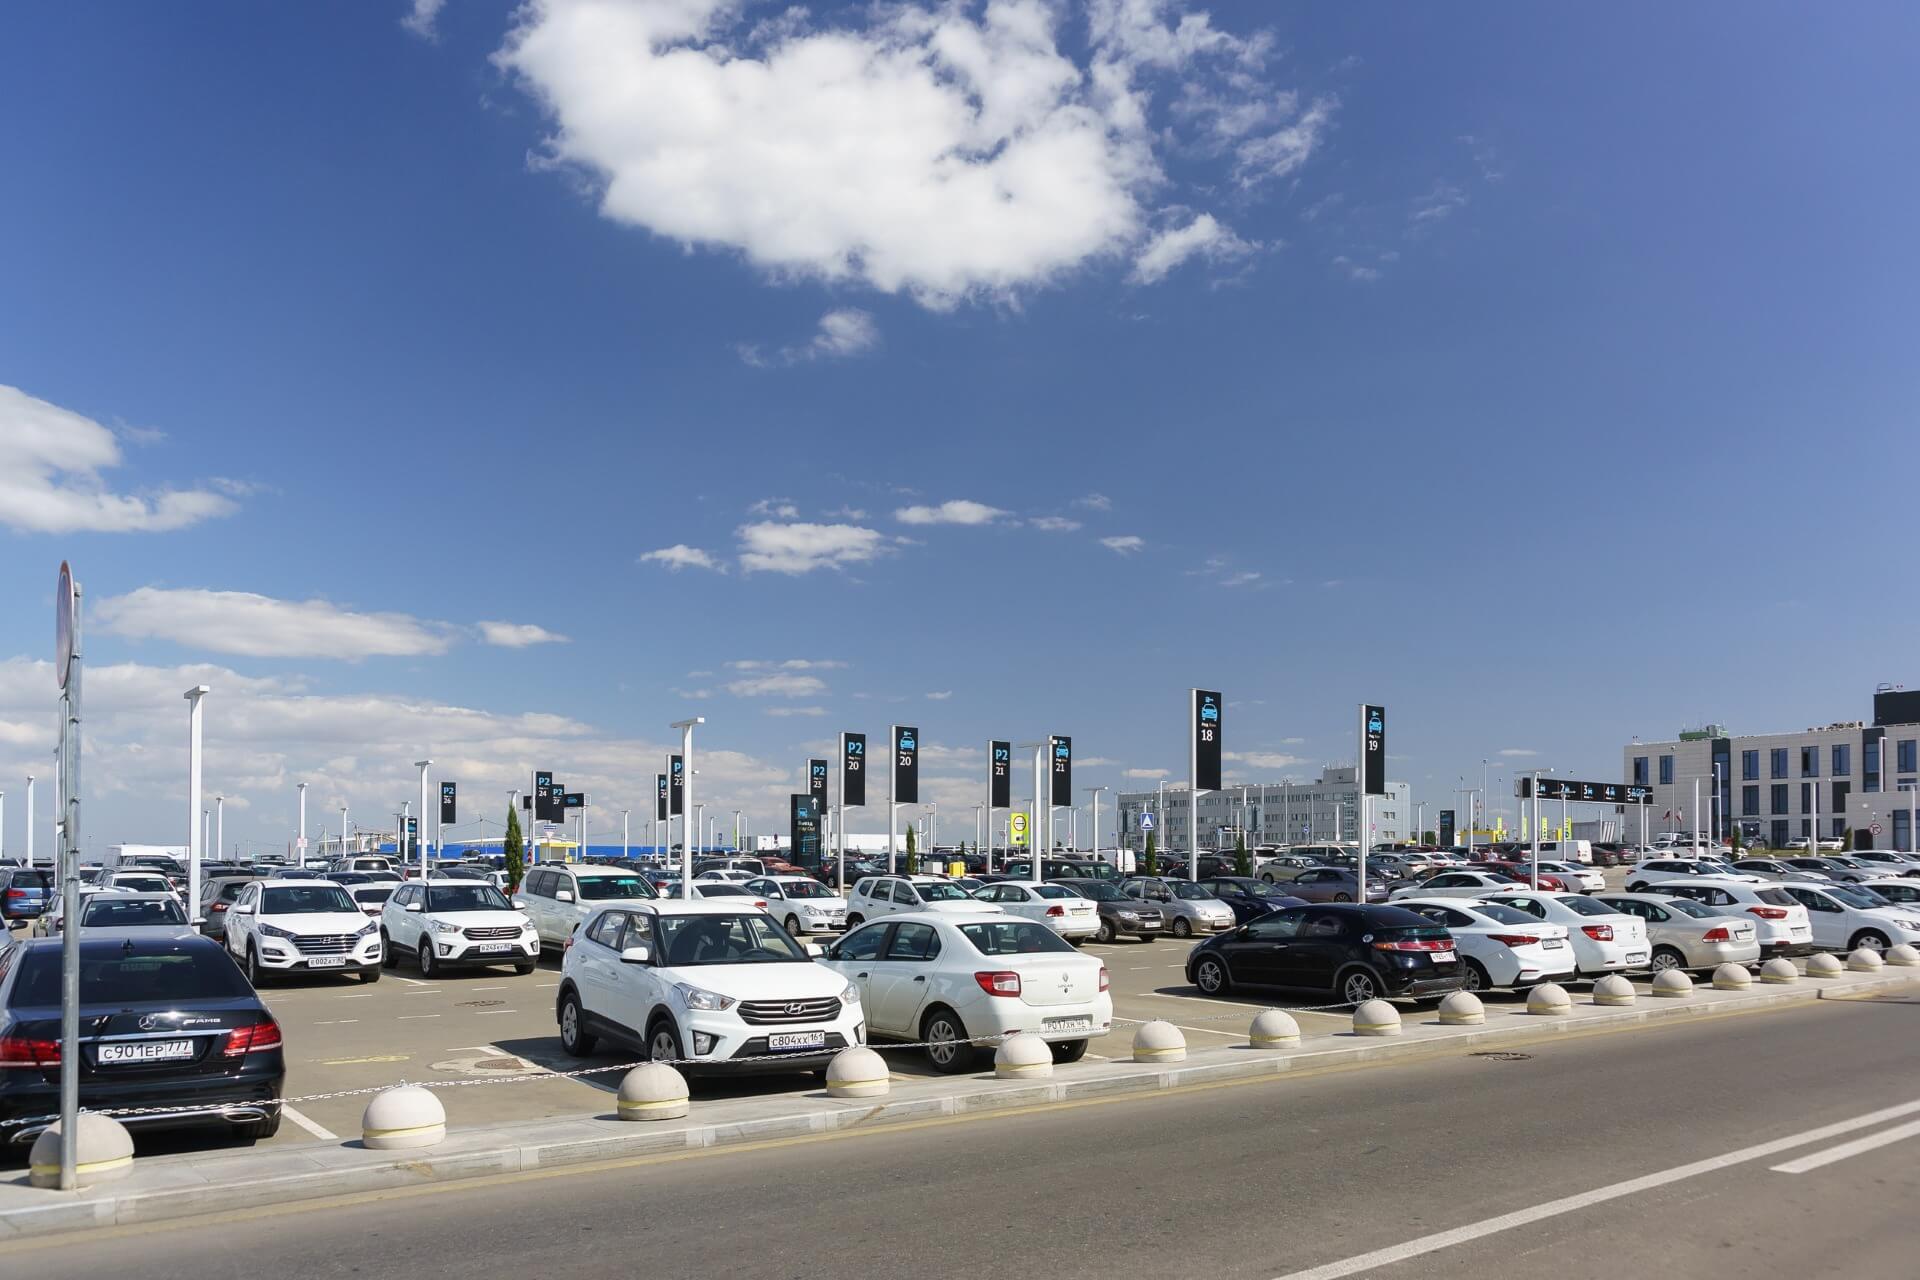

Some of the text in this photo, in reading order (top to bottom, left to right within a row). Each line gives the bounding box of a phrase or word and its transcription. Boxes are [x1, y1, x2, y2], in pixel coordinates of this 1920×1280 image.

[1201, 729, 1213, 741] 18
[848, 741, 863, 754] P2
[1369, 740, 1378, 751] 19
[995, 749, 1008, 760] P2
[848, 761, 859, 770] 20
[900, 756, 912, 766] 20
[813, 766, 825, 775] P2
[996, 767, 1004, 775] 21
[1056, 763, 1065, 772] 21
[538, 777, 551, 786] P2
[443, 786, 455, 795] P2
[553, 788, 564, 796] P2
[1584, 785, 1588, 795] 3
[1605, 787, 1610, 795] 4
[1627, 788, 1631, 797] 5
